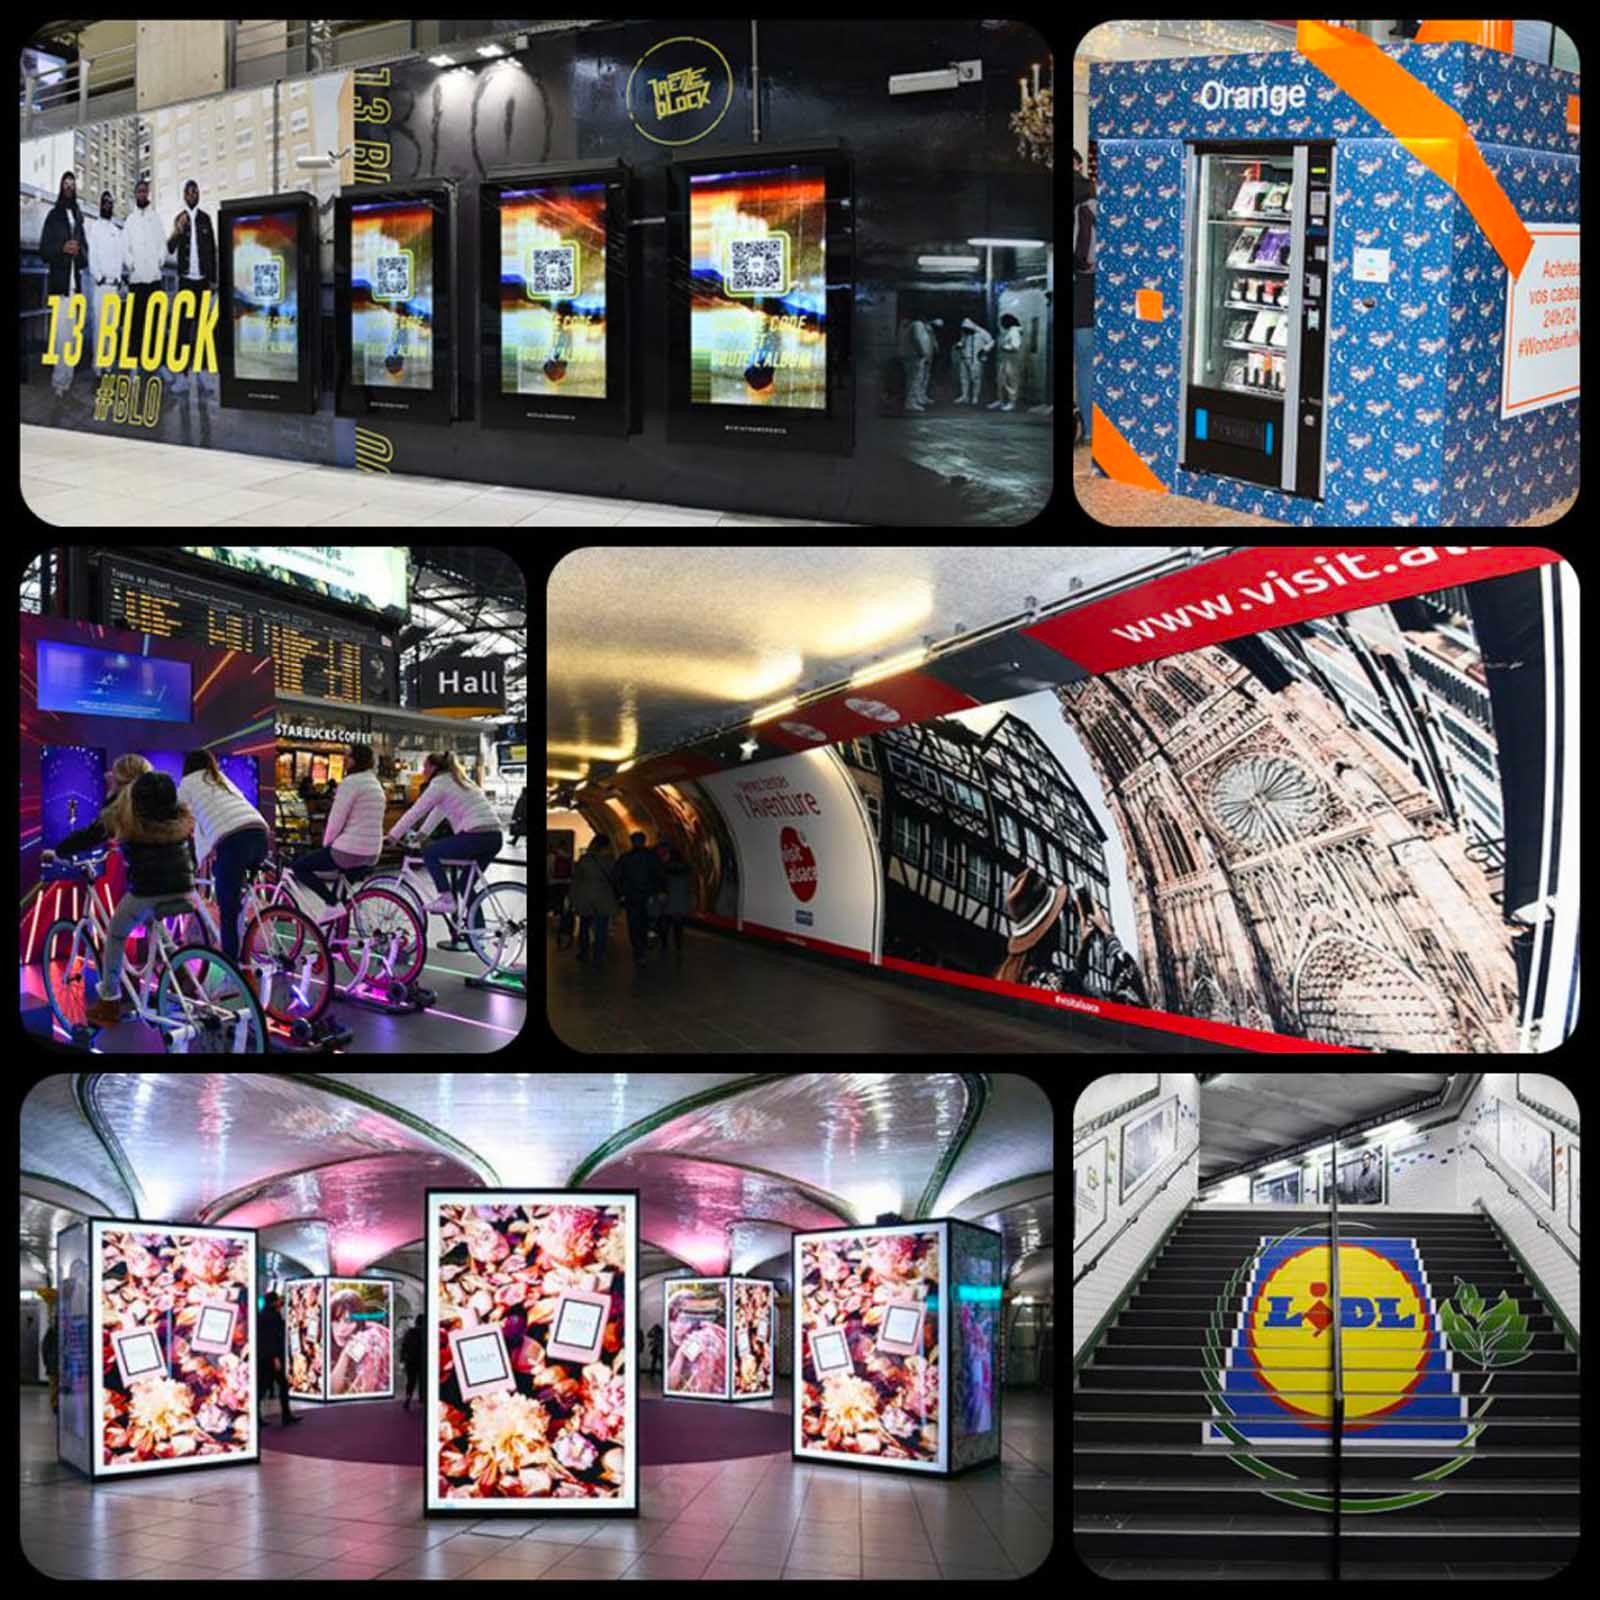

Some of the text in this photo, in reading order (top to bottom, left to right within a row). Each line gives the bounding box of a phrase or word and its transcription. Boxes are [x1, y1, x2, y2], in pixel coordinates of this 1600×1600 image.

[1200, 80, 1307, 115] Orange
[41, 290, 219, 373] 13 BLOCK
[94, 374, 162, 428] #BLO
[438, 669, 498, 694] Hall
[274, 721, 373, 745] STARBUCKS COFFEE
